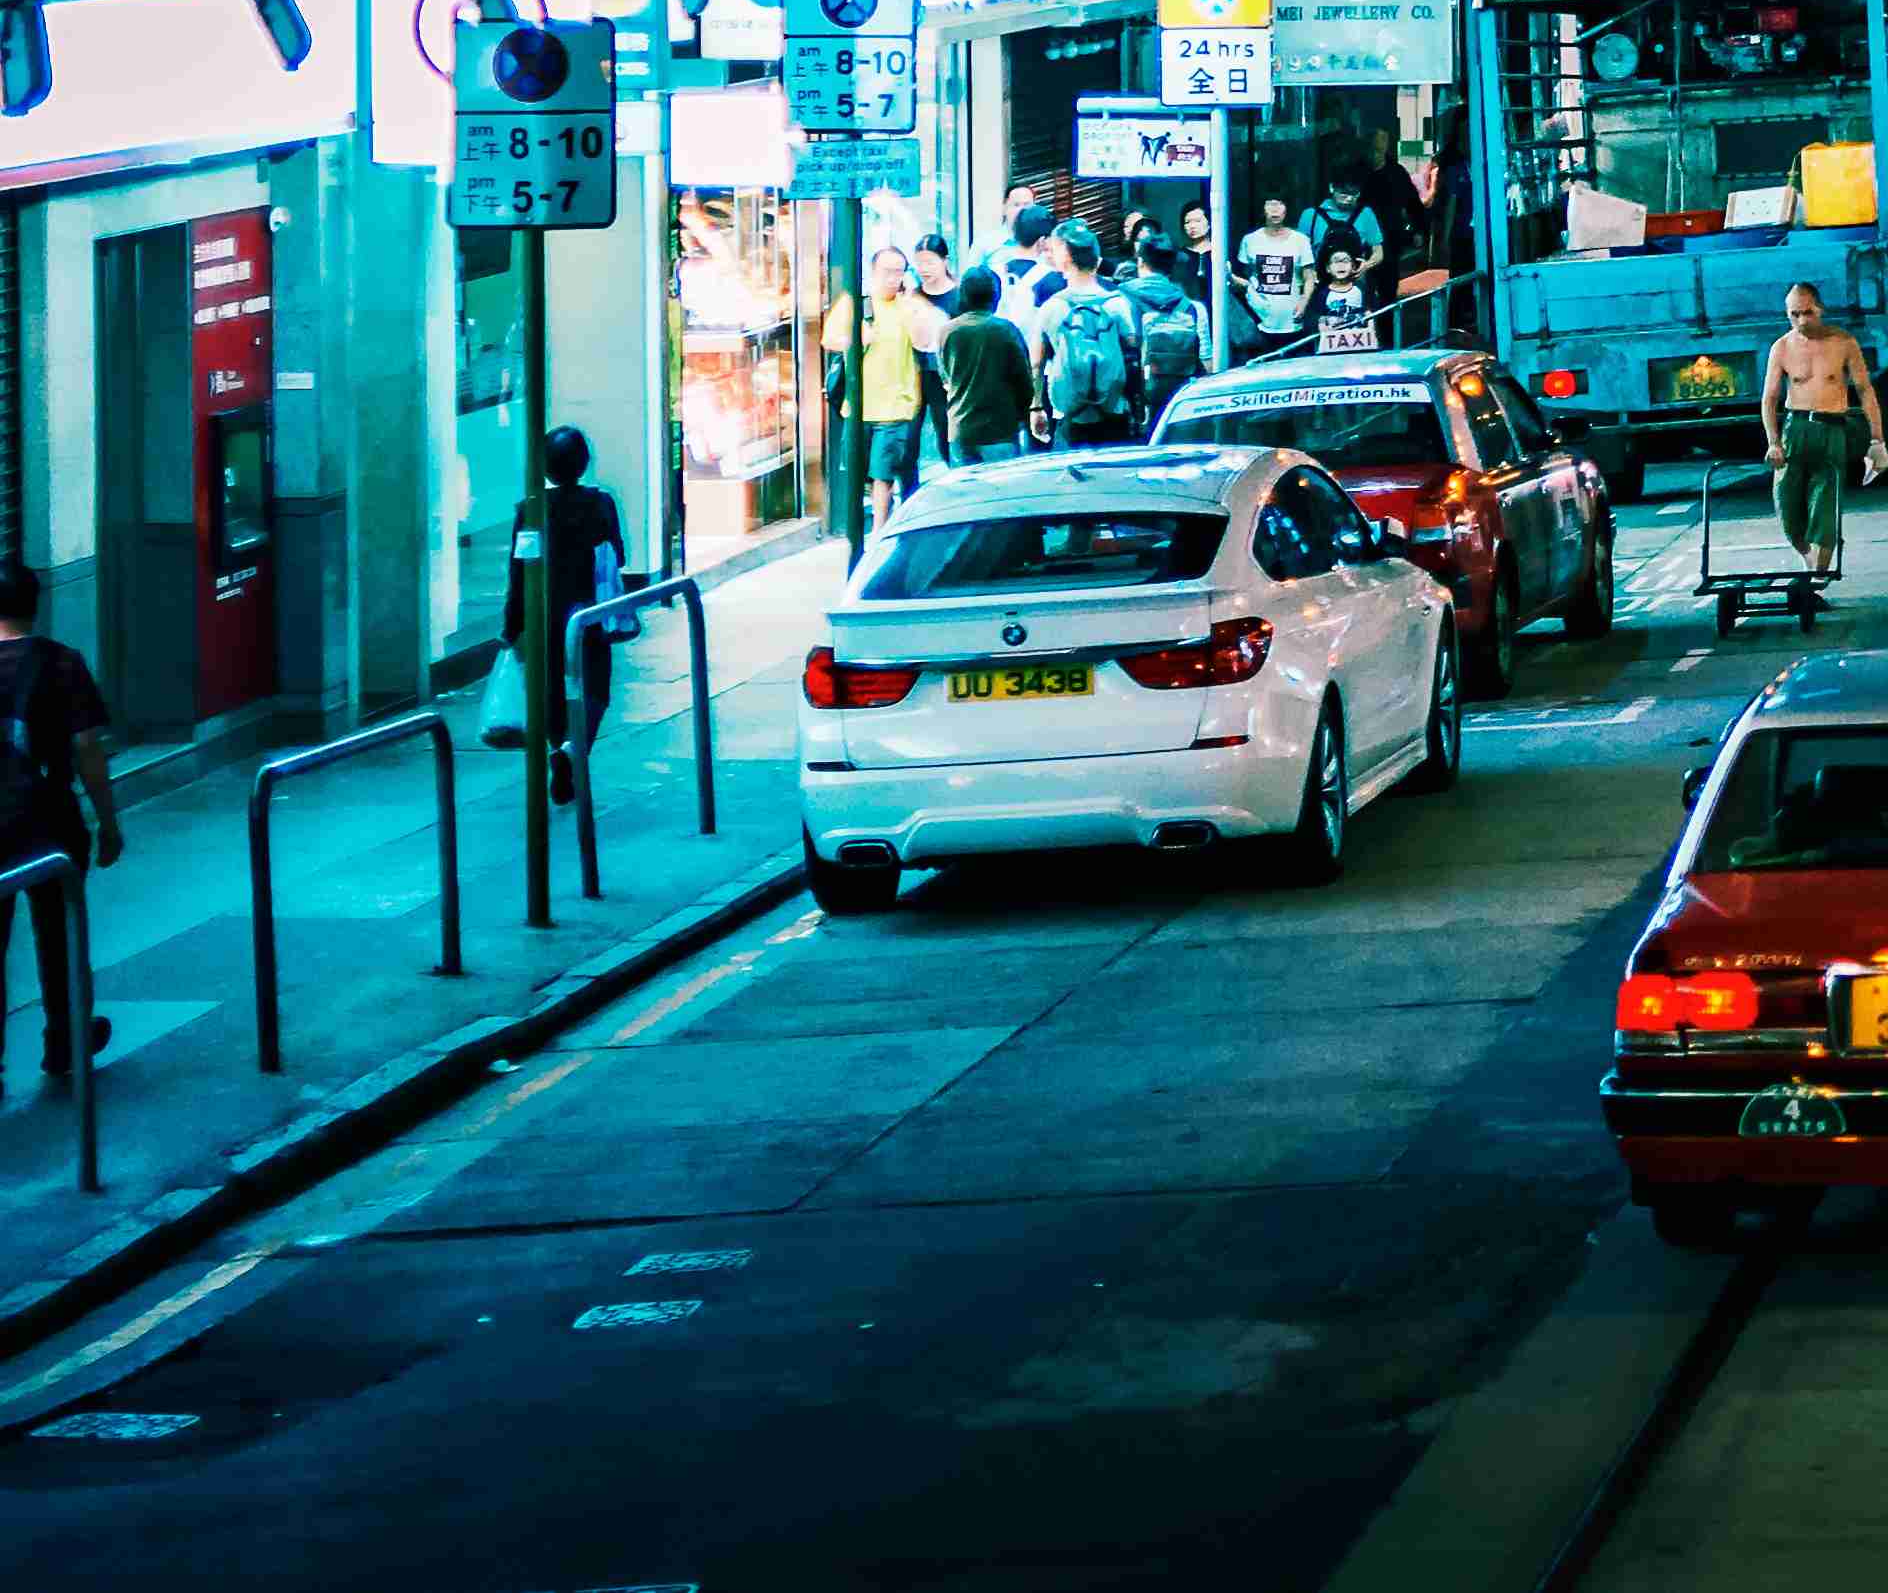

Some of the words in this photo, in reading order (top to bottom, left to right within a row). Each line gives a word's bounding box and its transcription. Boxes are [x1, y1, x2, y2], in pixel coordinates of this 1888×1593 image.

[1313, 5, 1400, 21] JEWELLERY
[1411, 6, 1436, 21] CO.
[797, 46, 821, 58] am
[1179, 39, 1211, 58] 24
[1218, 40, 1255, 58] hrs
[791, 61, 830, 78] 上午
[1188, 67, 1249, 95] 全日
[796, 88, 821, 102] pm
[467, 125, 495, 137] am
[460, 143, 501, 161] 上午
[467, 177, 496, 191] pm
[461, 194, 502, 215] 下午
[1326, 331, 1373, 350] TAXI
[1004, 669, 1089, 696] 3438
[1783, 1099, 1801, 1120] 4
